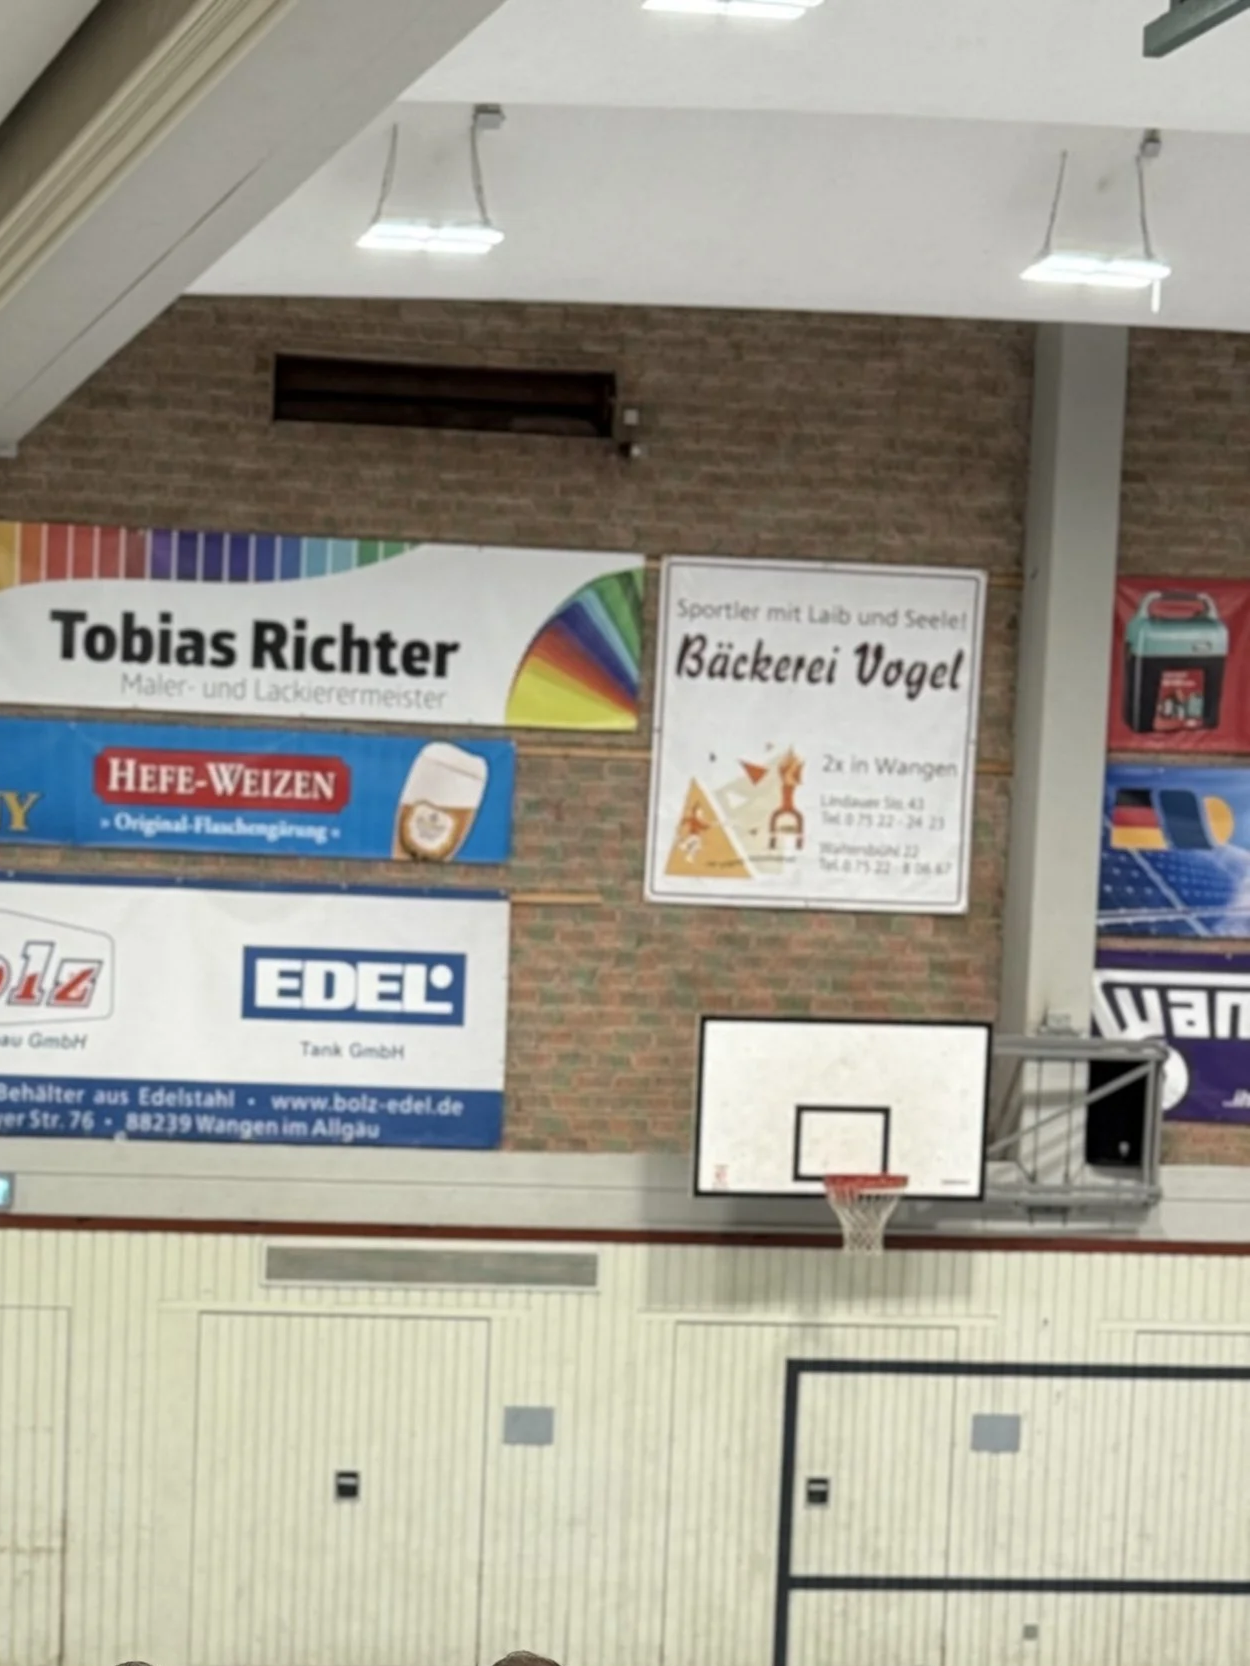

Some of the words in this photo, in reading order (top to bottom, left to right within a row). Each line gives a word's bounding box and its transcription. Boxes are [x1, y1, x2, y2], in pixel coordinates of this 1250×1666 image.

[676, 597, 761, 623] Sportler
[767, 603, 803, 625] mit
[807, 605, 853, 626] Laib
[858, 608, 899, 628] und
[904, 609, 969, 633] Seele!
[49, 610, 238, 671] Tobias
[252, 619, 460, 680] Richter
[675, 632, 841, 687] Bäckerei
[853, 641, 966, 702] Vogel
[120, 671, 196, 701] Maler-
[202, 676, 247, 703] und
[253, 678, 448, 713] Lackierermeister
[821, 753, 844, 774] 2x
[851, 754, 870, 775] in
[874, 756, 959, 783] Wangen
[254, 957, 454, 1015] EDEL
[28, 1031, 88, 1050] GmbH
[299, 1040, 343, 1058] Tank
[348, 1042, 405, 1060] GmbH
[93, 1088, 129, 1106] aus
[138, 1086, 236, 1109] Edelstahl
[270, 1093, 465, 1117] www.bolz-edel.de
[29, 1110, 65, 1130] Str.
[69, 1110, 95, 1131] 76
[125, 1112, 192, 1134] 88239
[196, 1114, 280, 1139] Wangen
[282, 1118, 308, 1137] im
[310, 1118, 382, 1143] Allgäu
